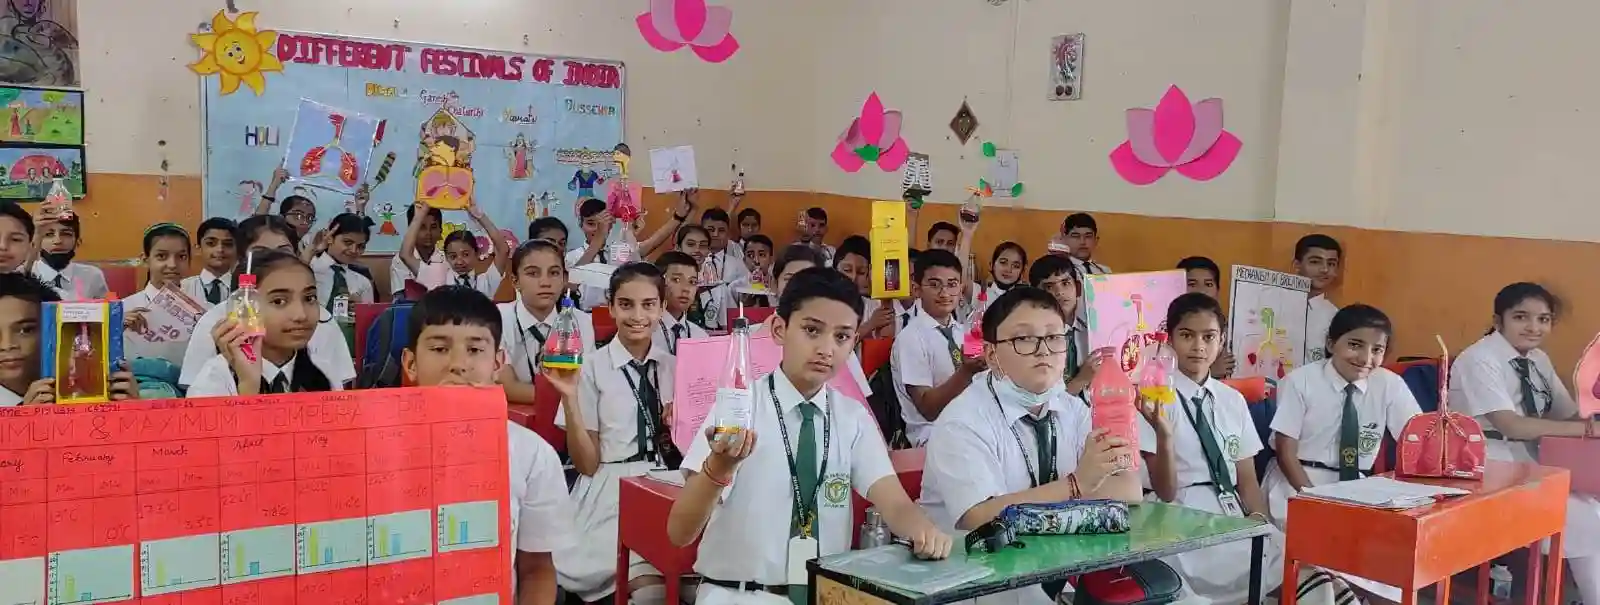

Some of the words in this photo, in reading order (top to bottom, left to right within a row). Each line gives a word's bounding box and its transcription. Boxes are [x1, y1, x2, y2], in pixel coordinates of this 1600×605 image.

[277, 33, 412, 71] DIFFERENT
[420, 48, 526, 81] FESTIVALS
[532, 59, 555, 83] OF
[562, 61, 621, 89] INDIA
[1271, 272, 1279, 285] OF
[89, 416, 113, 441] &
[119, 407, 238, 435] MAXIMUM
